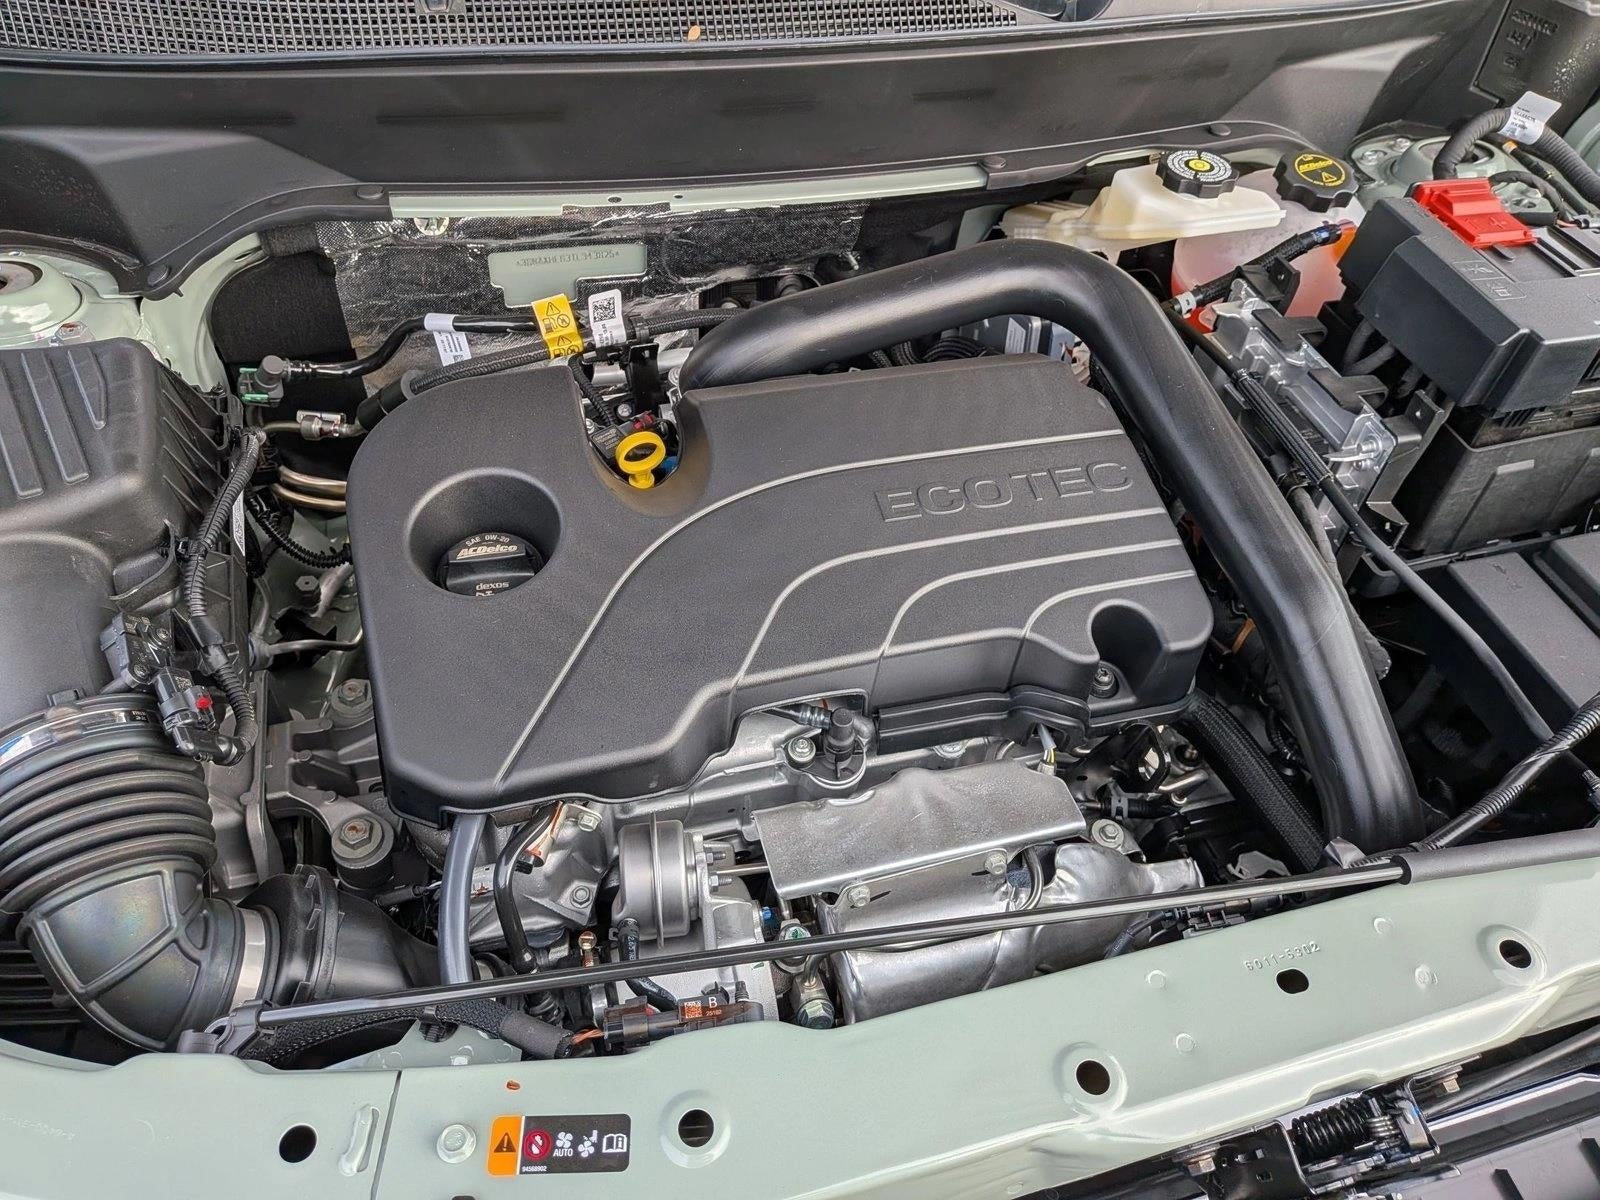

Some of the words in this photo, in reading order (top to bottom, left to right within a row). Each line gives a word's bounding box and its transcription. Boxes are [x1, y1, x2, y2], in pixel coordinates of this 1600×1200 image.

[874, 462, 1134, 522] ECOTEC
[465, 536, 481, 547] SAE
[484, 534, 510, 543] 0W-20
[456, 544, 518, 559] ACDelco
[475, 581, 509, 591] dexos
[708, 996, 718, 1008] B
[552, 1148, 574, 1157] AUTO
